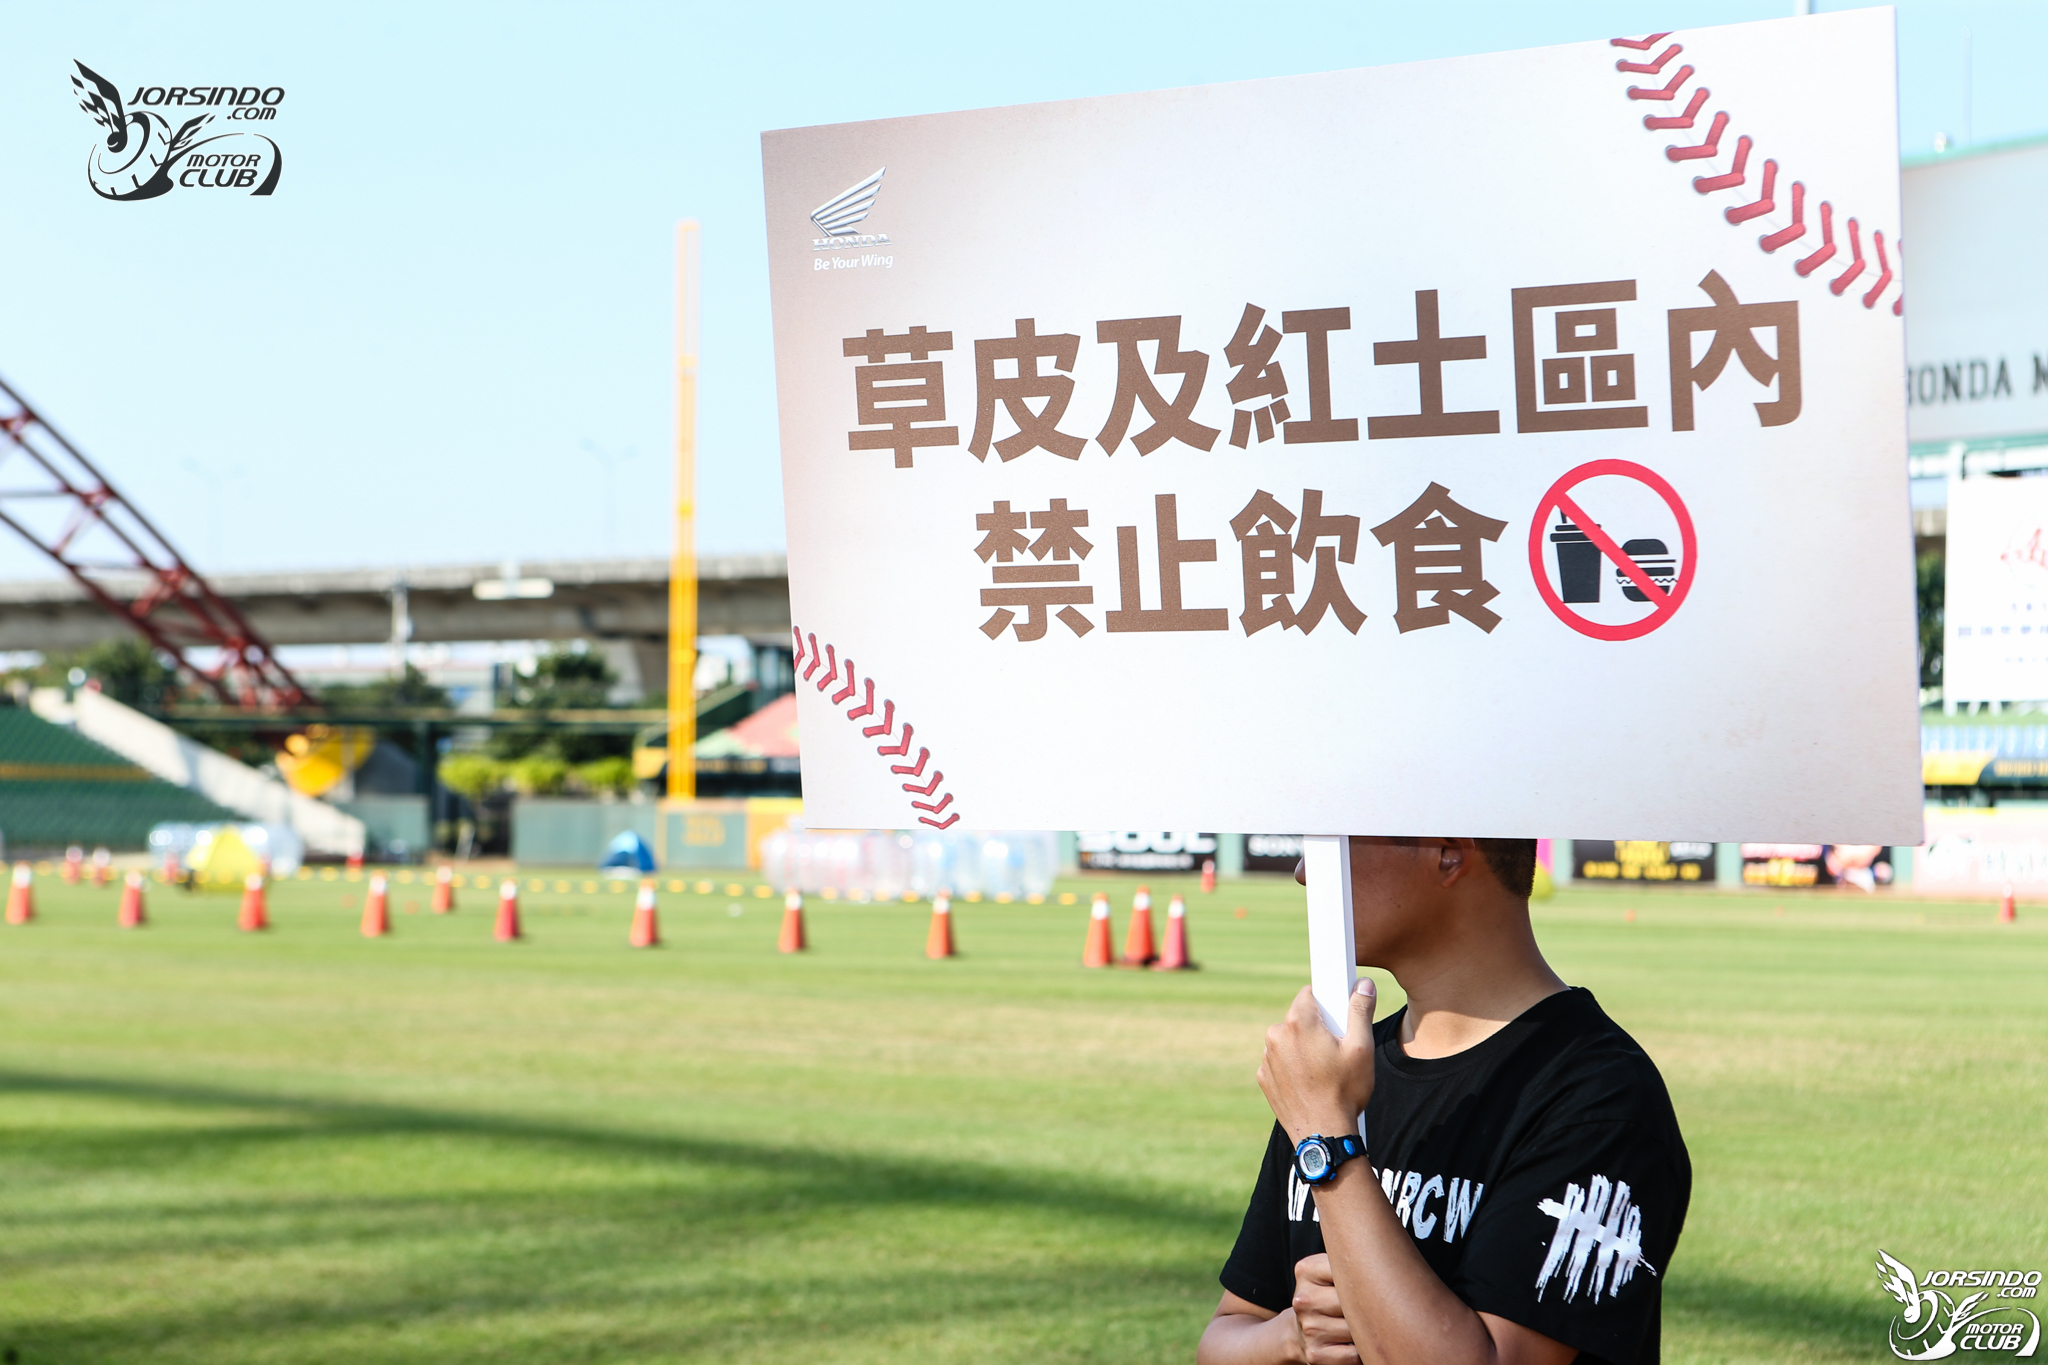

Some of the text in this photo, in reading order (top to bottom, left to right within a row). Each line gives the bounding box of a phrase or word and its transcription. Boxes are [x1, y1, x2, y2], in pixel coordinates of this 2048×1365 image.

[812, 233, 893, 251] HONDA
[814, 254, 894, 271] Be Your Wing
[844, 271, 1802, 468] 草皮及紅土區內
[1907, 358, 2012, 405] ONDA
[975, 482, 1508, 641] 禁止飲食
